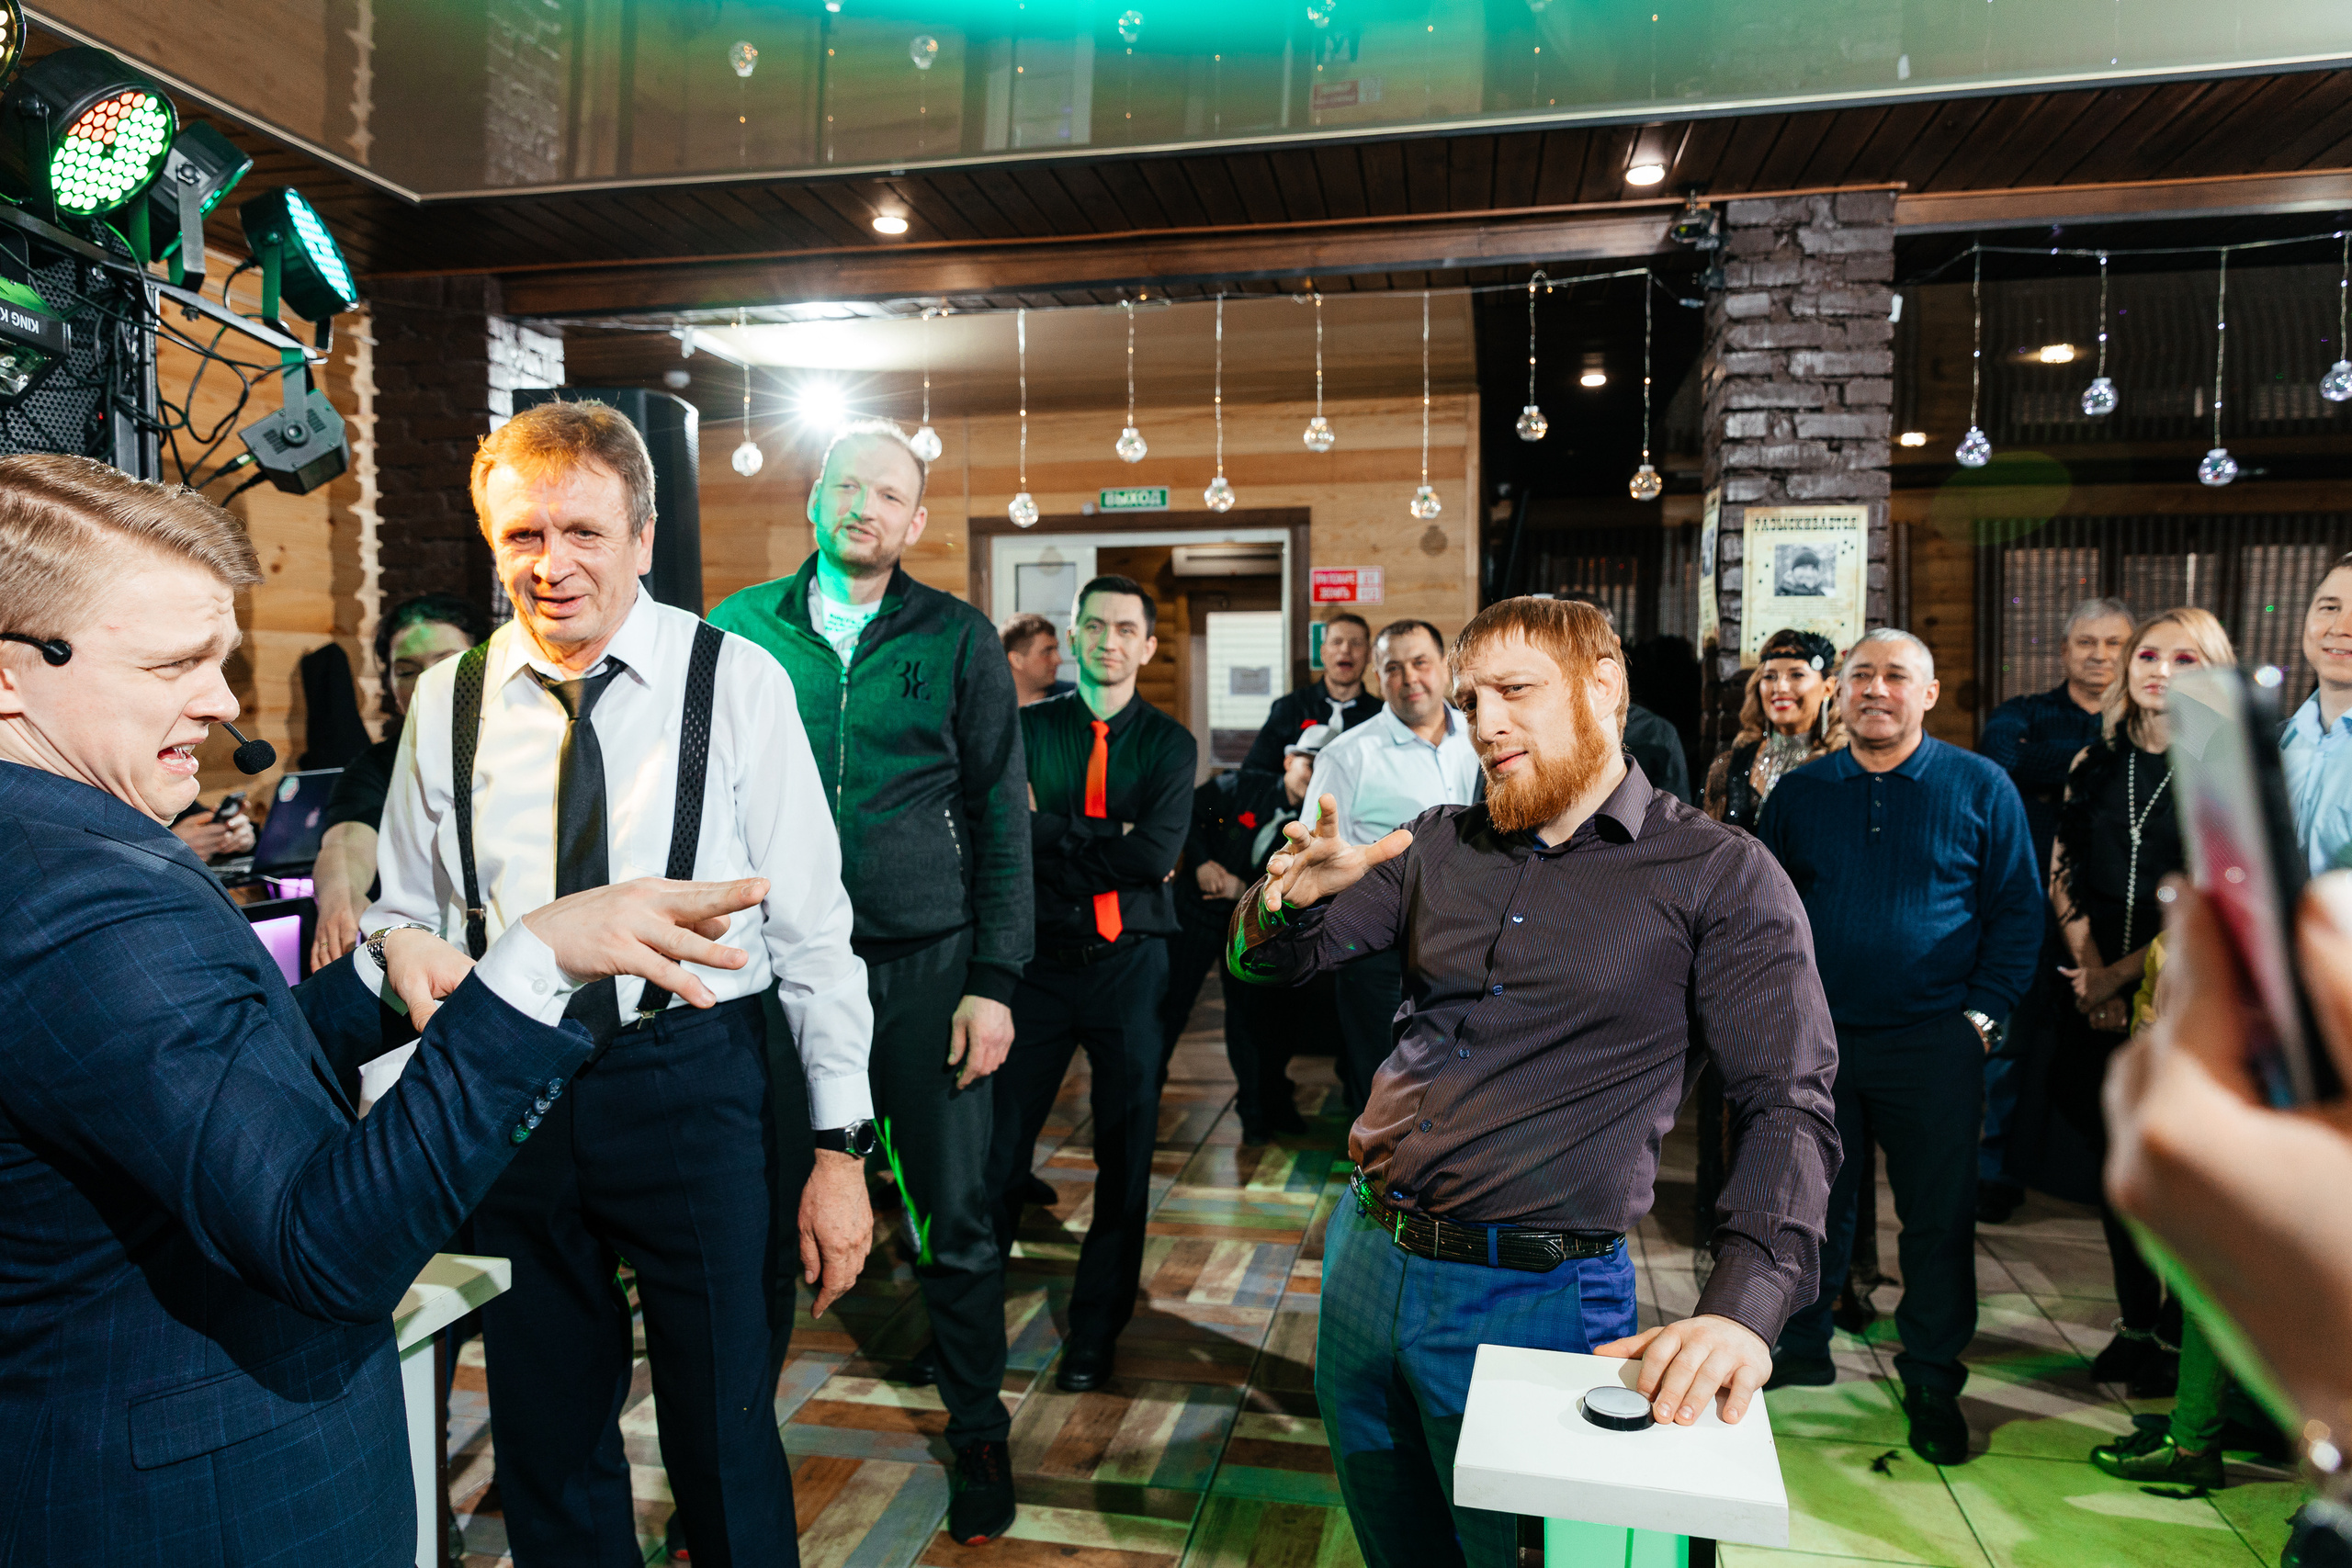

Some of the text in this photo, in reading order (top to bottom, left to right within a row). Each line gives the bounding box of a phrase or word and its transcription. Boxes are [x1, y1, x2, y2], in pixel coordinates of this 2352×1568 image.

[10, 310, 40, 334] KING
[1104, 490, 1161, 506] ВЫХОД
[1754, 517, 1857, 532] РАЗЫСКИВАЕТСЯ
